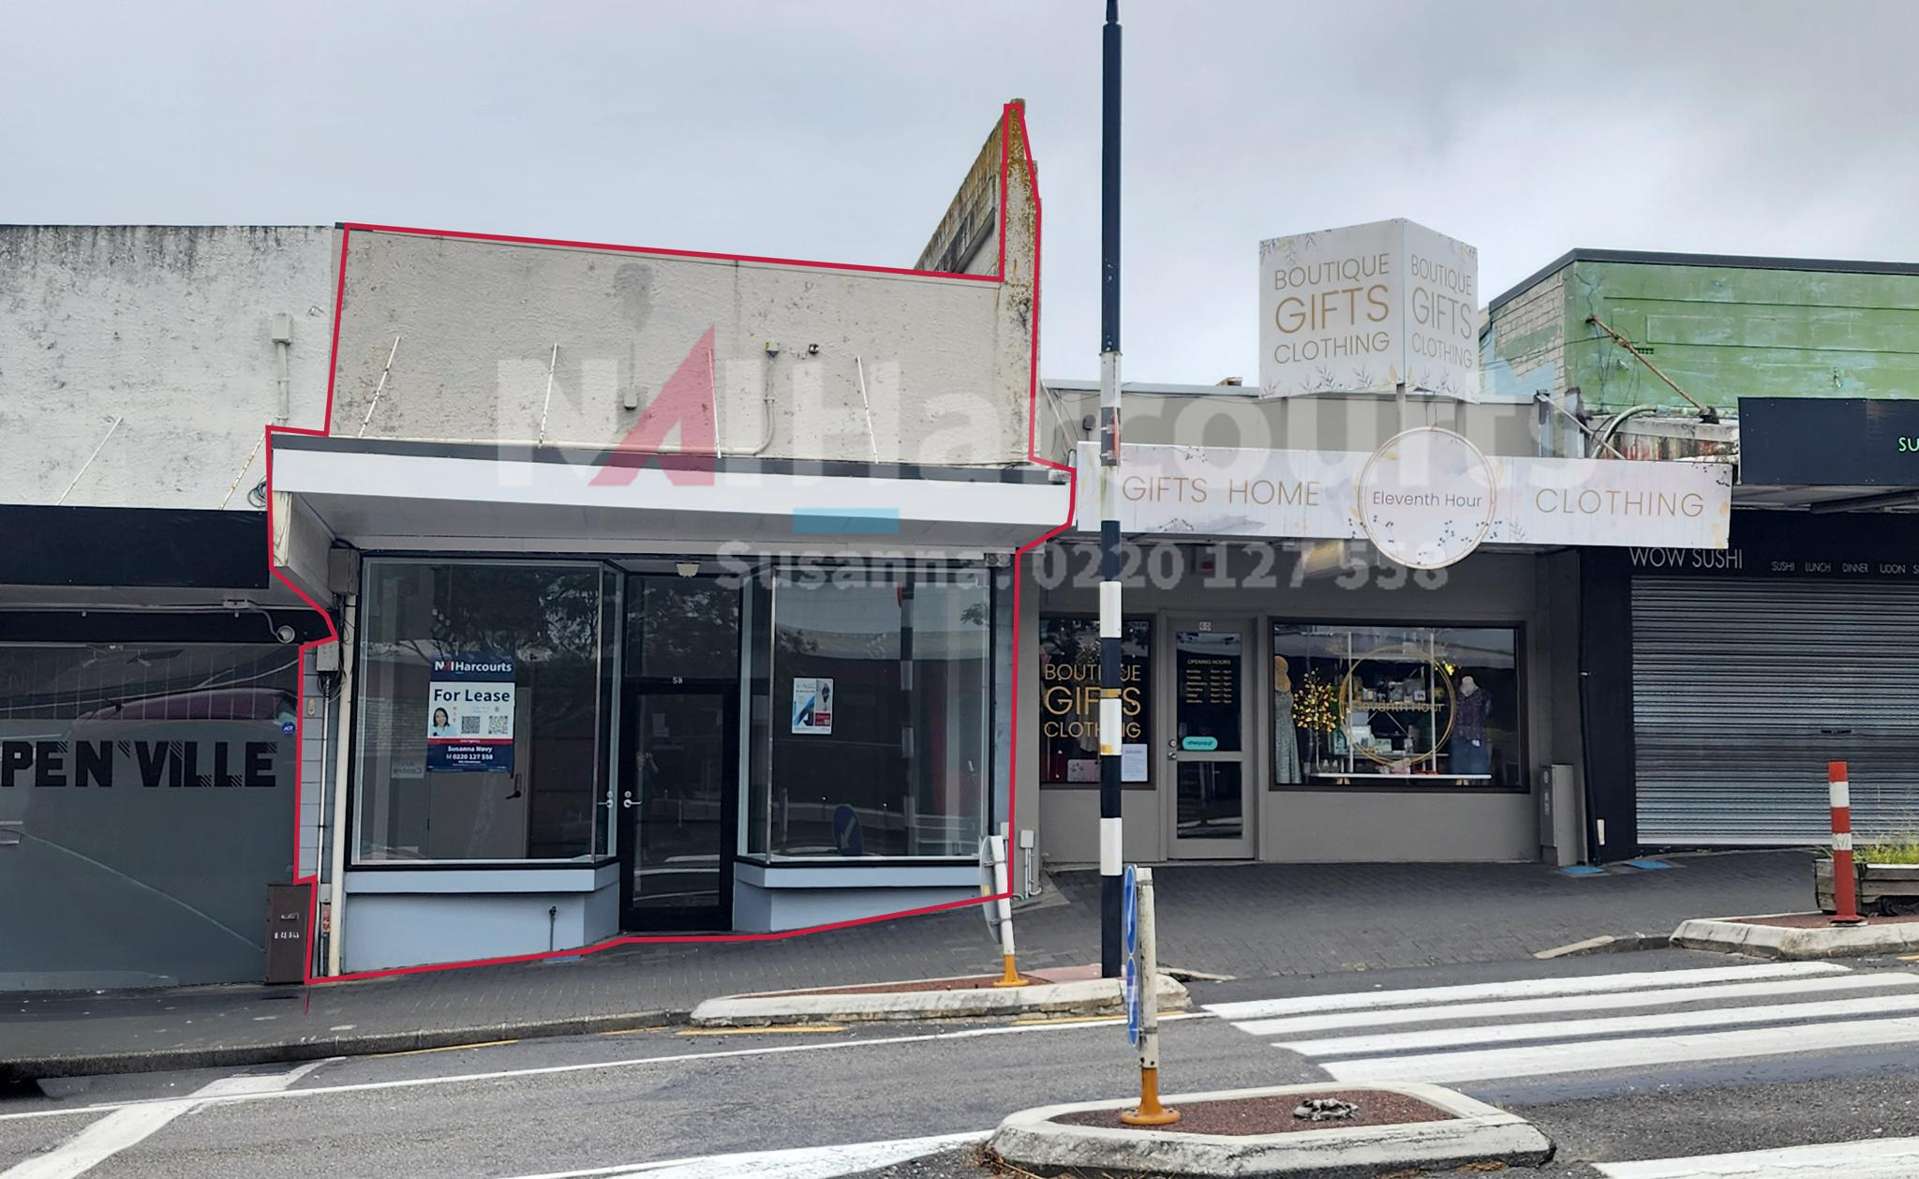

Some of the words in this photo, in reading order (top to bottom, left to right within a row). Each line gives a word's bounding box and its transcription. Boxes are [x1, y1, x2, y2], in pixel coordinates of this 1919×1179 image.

[1274, 253, 1390, 290] BOUTIQUE
[1411, 254, 1472, 296] BOUTIQUE
[1275, 284, 1390, 334] GIFTS
[1412, 287, 1473, 340] GIFTS
[1274, 331, 1390, 364] CLOTHING
[1412, 332, 1473, 369] CLOTHING
[1122, 475, 1208, 503] GIFTS
[1229, 479, 1321, 506] HOME
[1372, 490, 1440, 506] Eleventh
[1445, 492, 1482, 507] Hour
[1536, 487, 1704, 518] CLOTHING
[1628, 546, 1686, 568] WOW
[1692, 548, 1743, 569] SUSHI
[1770, 561, 1795, 572] SUSHI
[455, 661, 512, 673] Harcourts
[1045, 663, 1142, 682] BOUTIUE
[434, 689, 461, 702] For
[465, 689, 511, 702] Lease
[1046, 686, 1142, 716] GIFS
